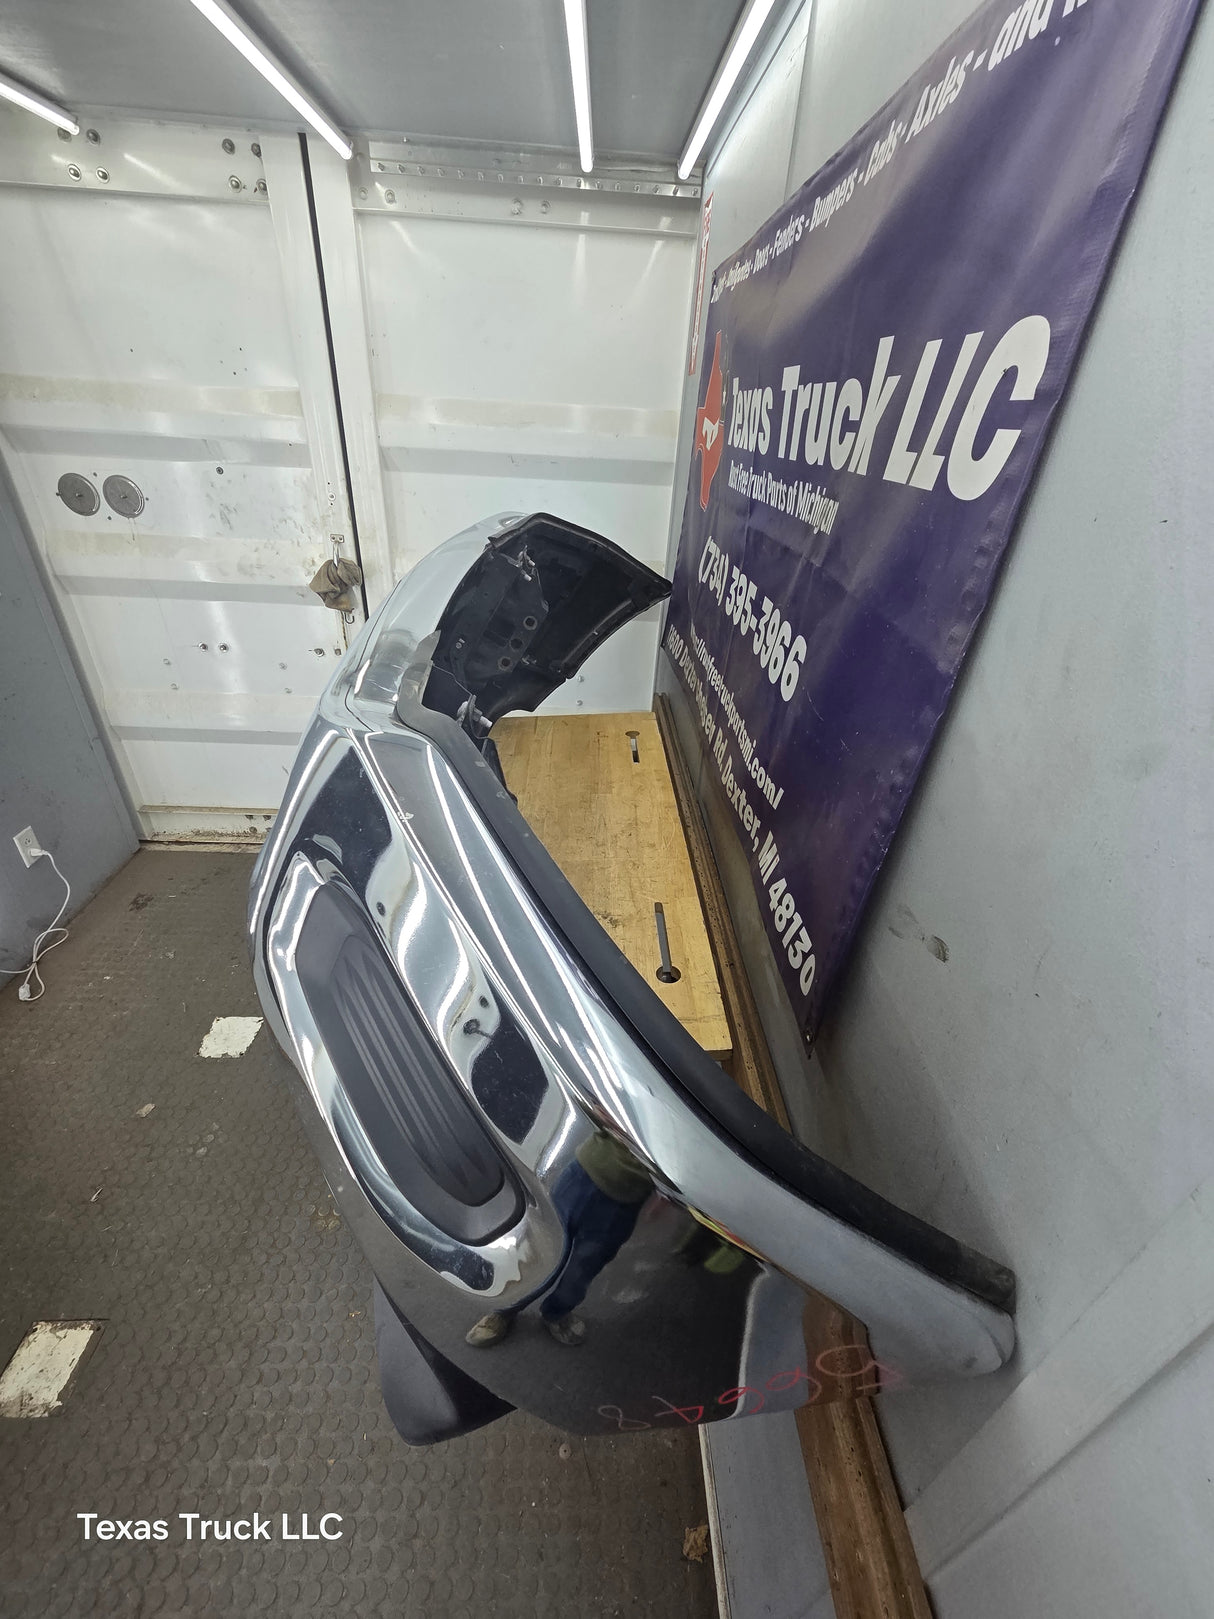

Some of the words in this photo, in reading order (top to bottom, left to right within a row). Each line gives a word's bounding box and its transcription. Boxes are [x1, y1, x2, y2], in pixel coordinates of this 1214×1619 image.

[772, 214, 805, 260] Fenders
[809, 168, 858, 232] Bumpers
[863, 119, 903, 187] Cabs
[904, 50, 975, 144] Axles
[727, 376, 773, 456] Texas
[778, 335, 902, 477] Truck
[882, 314, 1051, 501] LLC
[747, 466, 767, 503] Truck
[766, 472, 787, 512] Parts
[786, 480, 798, 516] of
[795, 481, 840, 536] Michigan
[698, 535, 729, 607] (734)
[725, 565, 808, 702] 395-3966
[721, 755, 762, 853] Dexter,
[768, 877, 816, 997] 48130
